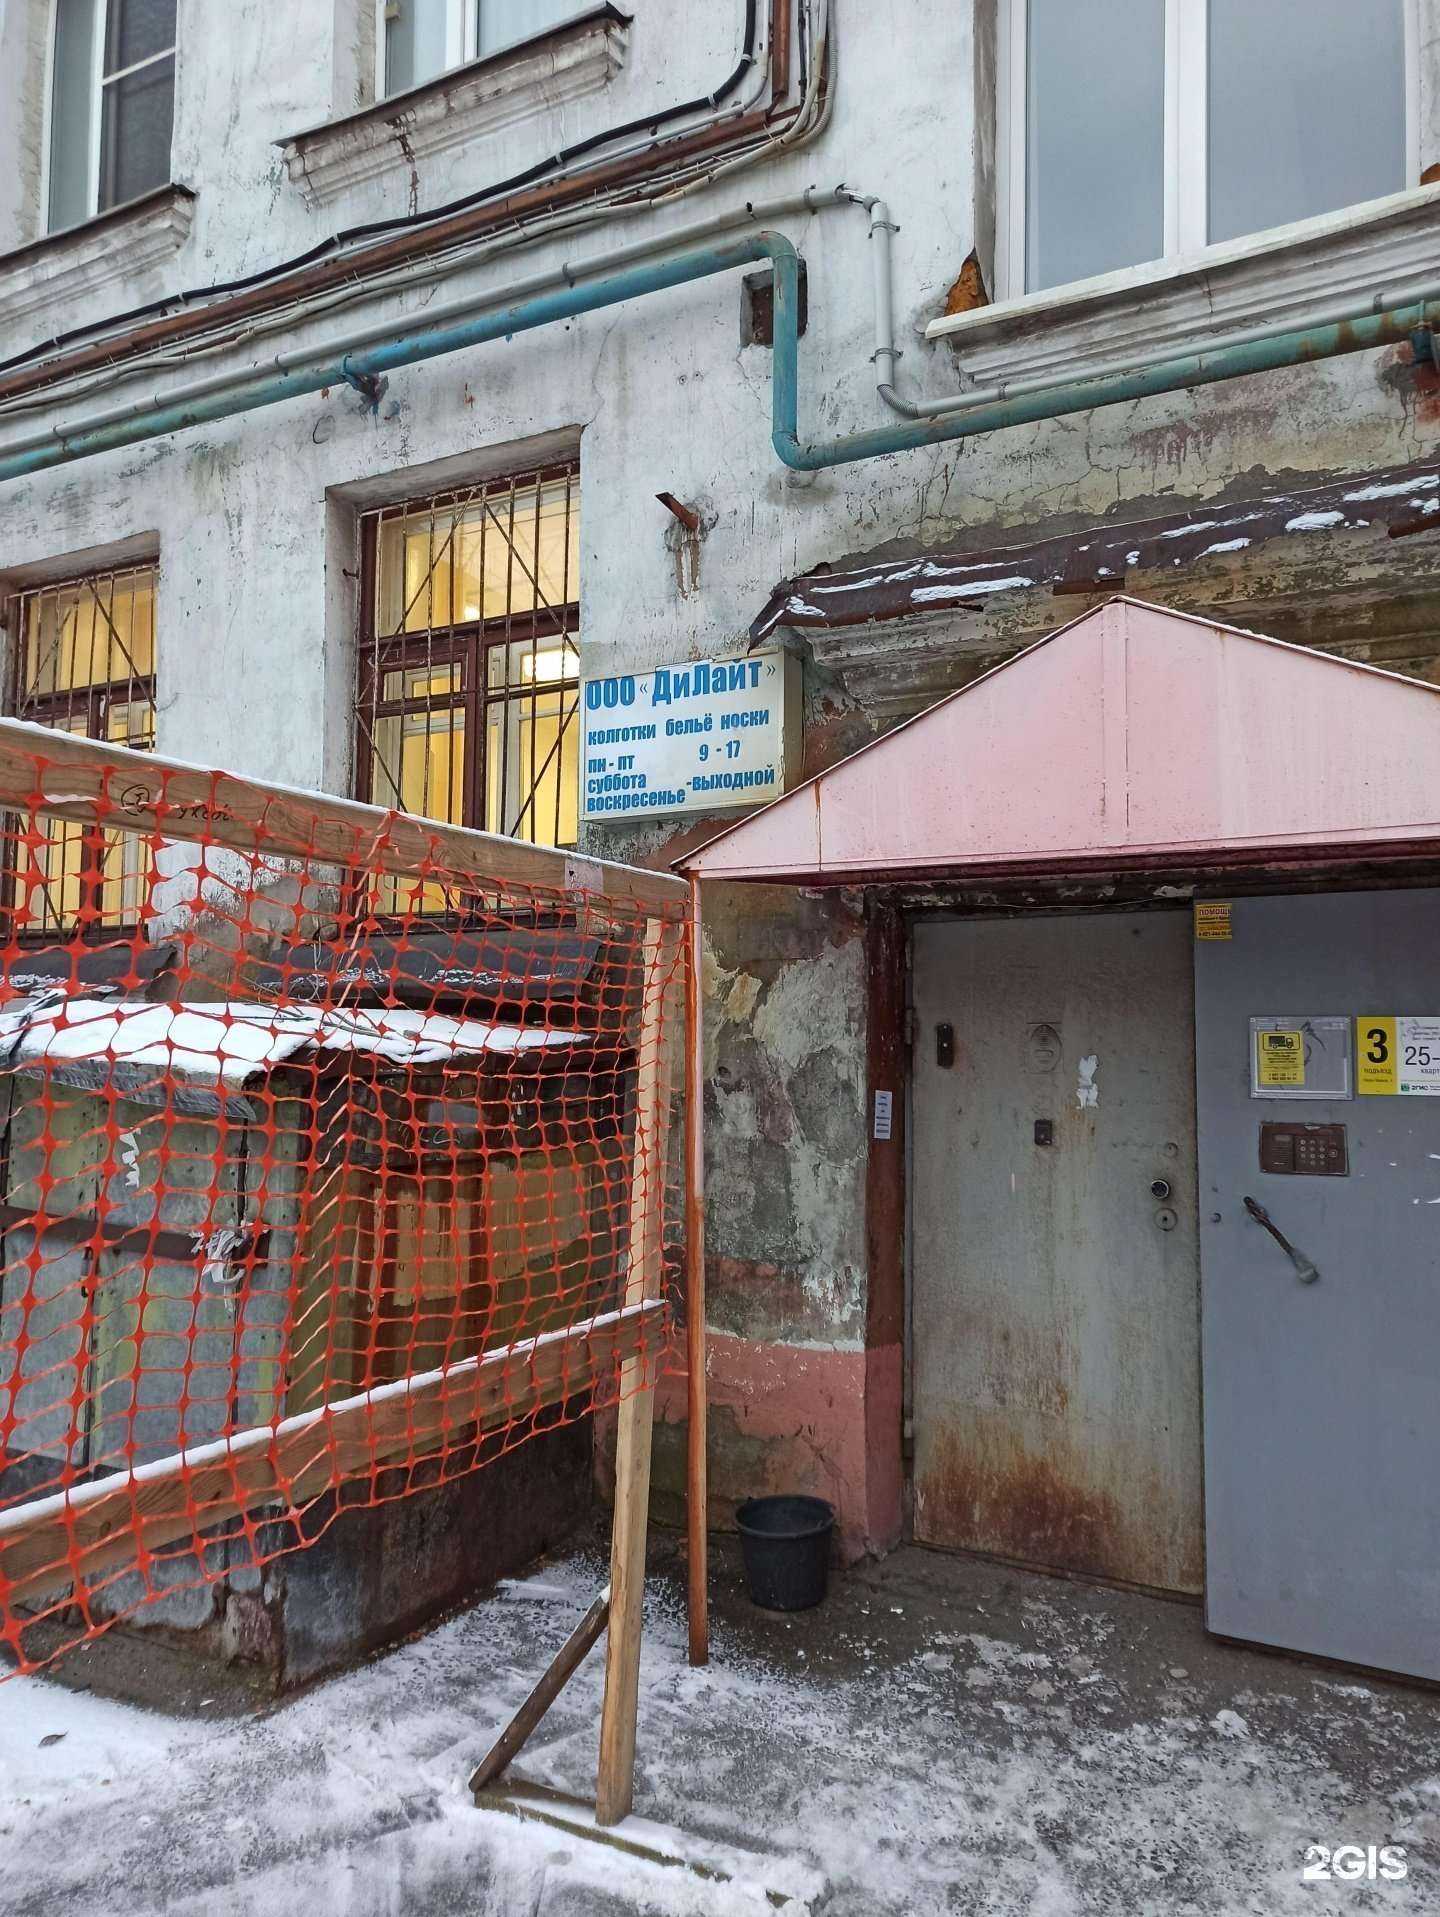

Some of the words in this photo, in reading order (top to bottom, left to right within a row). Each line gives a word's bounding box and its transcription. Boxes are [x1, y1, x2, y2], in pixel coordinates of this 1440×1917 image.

[587, 676, 636, 710] ООО
[588, 724, 657, 746] колготки
[665, 713, 713, 737] бельё
[720, 709, 769, 730] носки
[587, 788, 686, 812] воскресенье
[588, 773, 647, 795] суббота
[1367, 1028, 1389, 1064] 3
